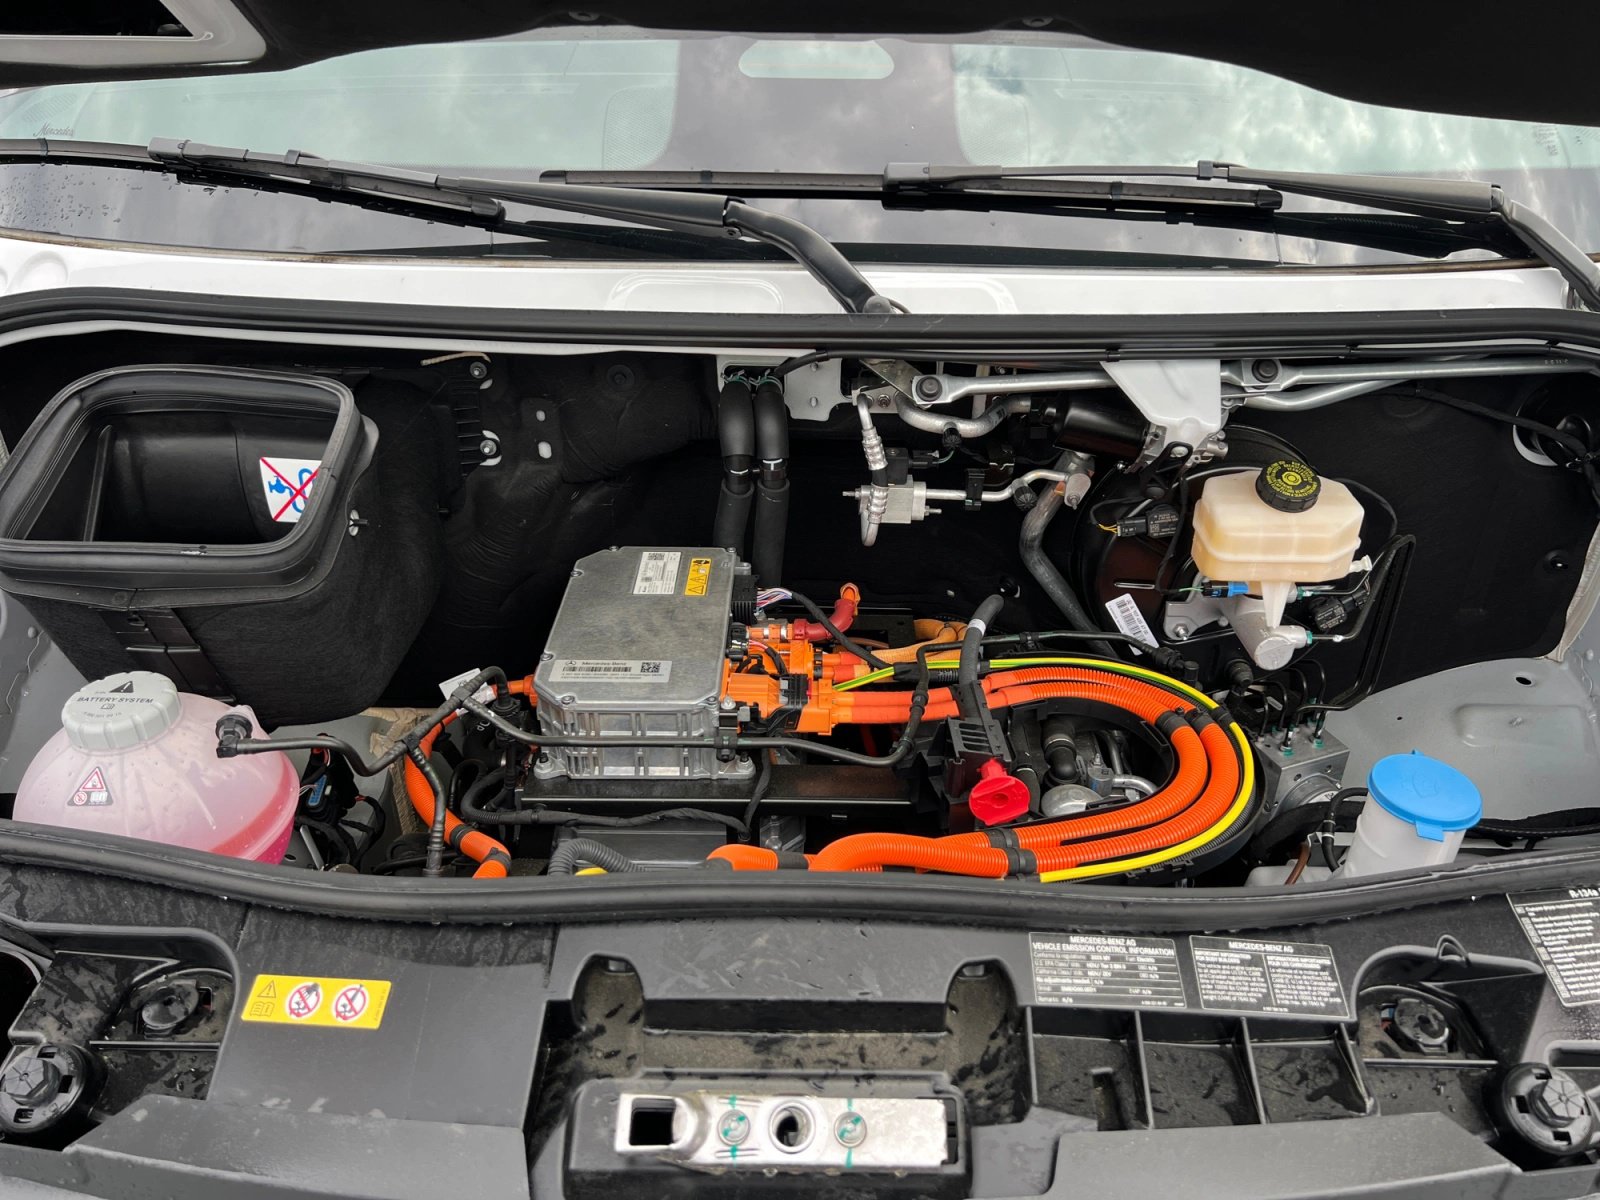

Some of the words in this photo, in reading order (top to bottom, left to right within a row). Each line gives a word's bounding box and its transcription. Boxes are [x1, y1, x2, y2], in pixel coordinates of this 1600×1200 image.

[1568, 888, 1599, 899] R-134a
[1070, 936, 1125, 945] MERCEDES-BENZ
[1032, 941, 1060, 950] VEHICLE
[1062, 943, 1095, 952] EMISSION
[1095, 945, 1128, 953] CONTROL
[1129, 946, 1174, 955] INFORMATION
[1228, 941, 1283, 952] MERCEDES-BENZ
[1283, 944, 1294, 952] AG
